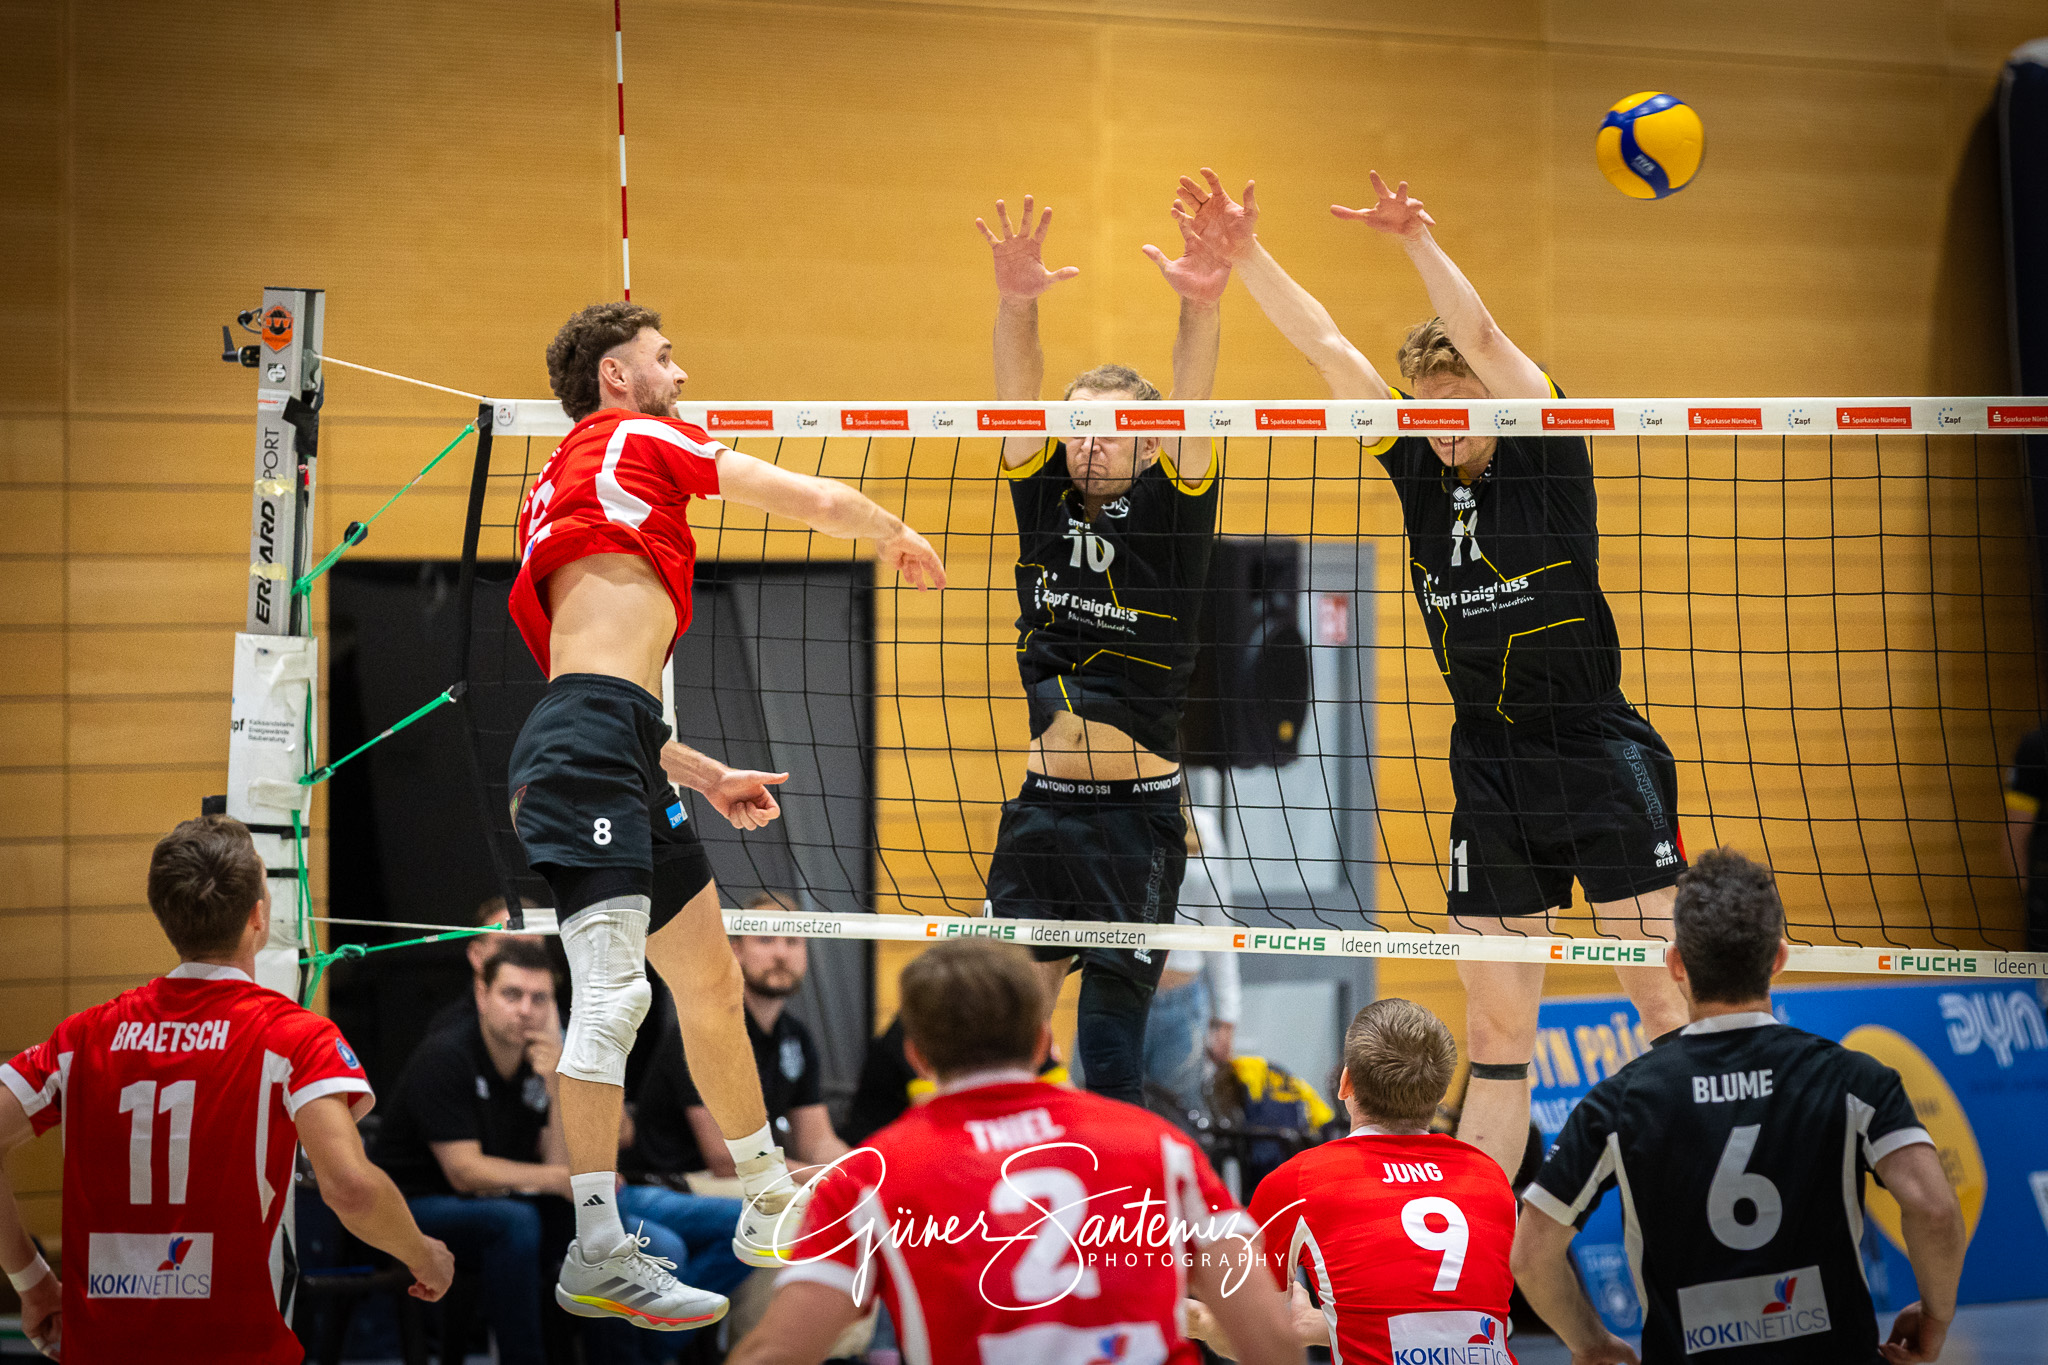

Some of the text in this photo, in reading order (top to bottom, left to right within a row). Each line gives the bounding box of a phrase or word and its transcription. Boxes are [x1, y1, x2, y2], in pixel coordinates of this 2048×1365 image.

[802, 419, 818, 427] Zapf
[938, 419, 953, 427] Zapf
[1076, 419, 1091, 427] Zapf
[1130, 418, 1180, 426] Sparkasse Nürnberg
[1215, 418, 1231, 427] Zapf
[1270, 418, 1321, 426] Sparkasse Nürnberg
[1357, 418, 1373, 427] Zapf
[1412, 418, 1464, 426] Sparkasse Nürnberg
[1500, 418, 1516, 426] Zapf
[1557, 418, 1610, 426] Sparkasse Nürnberg
[1646, 418, 1662, 426] Zapf
[1704, 417, 1757, 426] Sparkasse Nürnberg
[1794, 417, 1810, 426] Zapf
[1852, 416, 1907, 425] Sparkasse Nürnberg
[1944, 416, 1961, 424] Zapf
[257, 427, 280, 625] ERARD PORT
[1451, 510, 1482, 566] 11
[1062, 529, 1115, 572] 10
[1430, 577, 1529, 610] Zapf Daigfuss
[1042, 589, 1138, 622] Zapf Daigfuss
[231, 718, 244, 733] pf
[1035, 779, 1111, 795] ANTONIO ROSSI
[1132, 779, 1171, 793] ANTONIO
[592, 818, 612, 846] 8
[730, 916, 842, 934] Ideen umsetzen
[946, 924, 1146, 944] FUCHS Ideen umsetzen
[1254, 935, 1460, 956] FUCHS Ideen umsetzen
[1572, 946, 1646, 962] FUCHS
[1901, 956, 1977, 973] FUCHS
[1994, 958, 2037, 974] Ideen
[110, 1020, 230, 1052] BRAETSCH
[1692, 1069, 1774, 1103] BLUME
[119, 1080, 196, 1204] 11
[1382, 1162, 1444, 1183] JUNG
[1706, 1123, 1782, 1251] 6
[990, 1166, 1102, 1303] 2
[1401, 1196, 1469, 1291] 9
[89, 1274, 210, 1297] KOKINETICS
[1686, 1307, 1828, 1351] KOKINETICS
